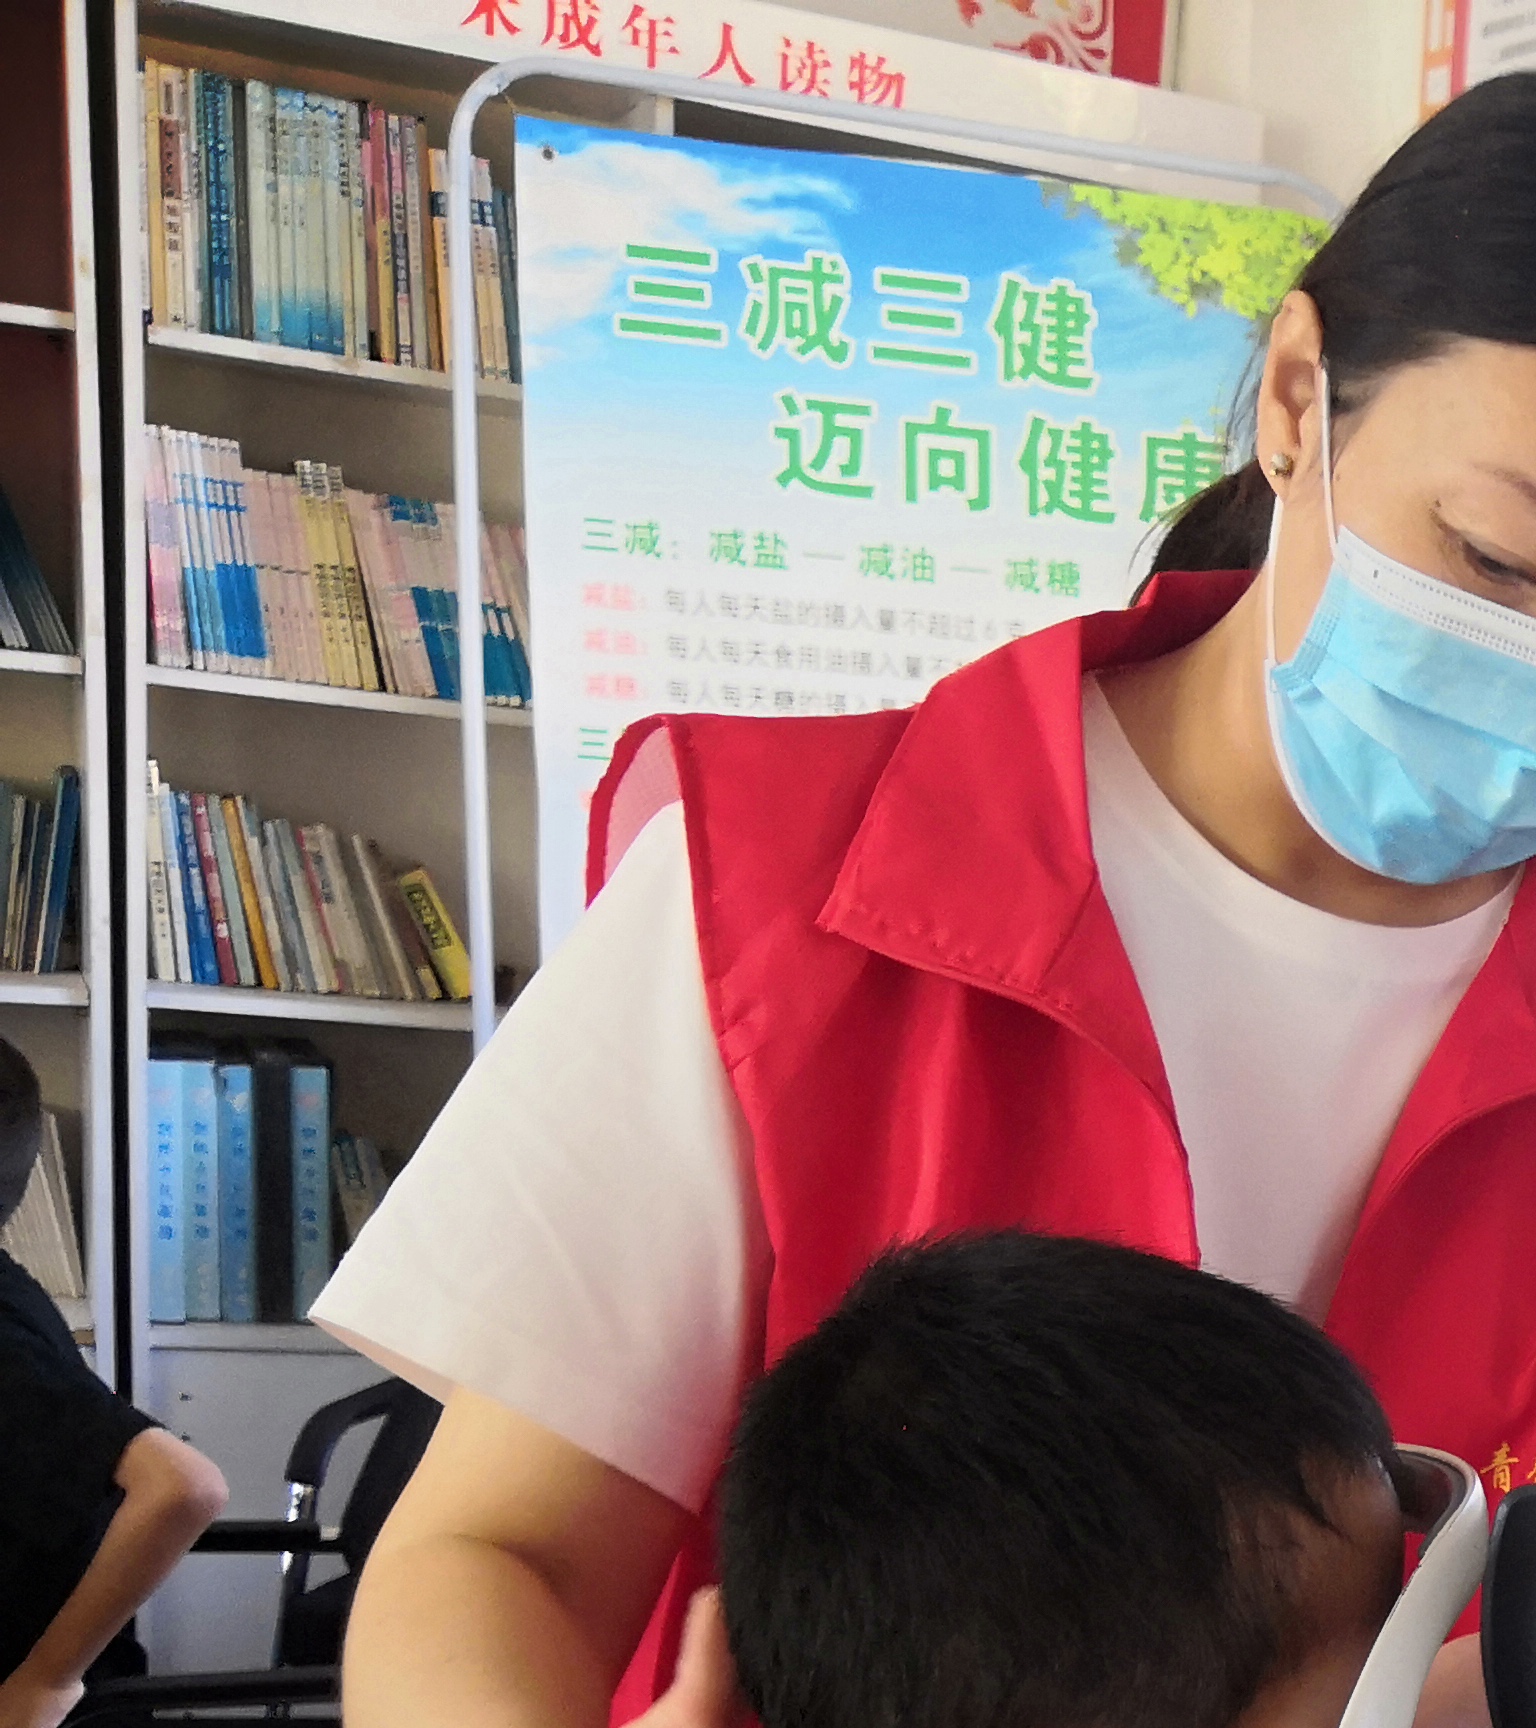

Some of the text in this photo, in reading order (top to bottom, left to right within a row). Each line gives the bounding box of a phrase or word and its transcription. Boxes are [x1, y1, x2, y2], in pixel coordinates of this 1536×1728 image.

[614, 243, 1094, 389] 三减三健
[773, 393, 1227, 526] 迈向健康
[708, 528, 789, 571] 减盐
[858, 544, 936, 585] 减油
[1005, 557, 1082, 599] 减糖
